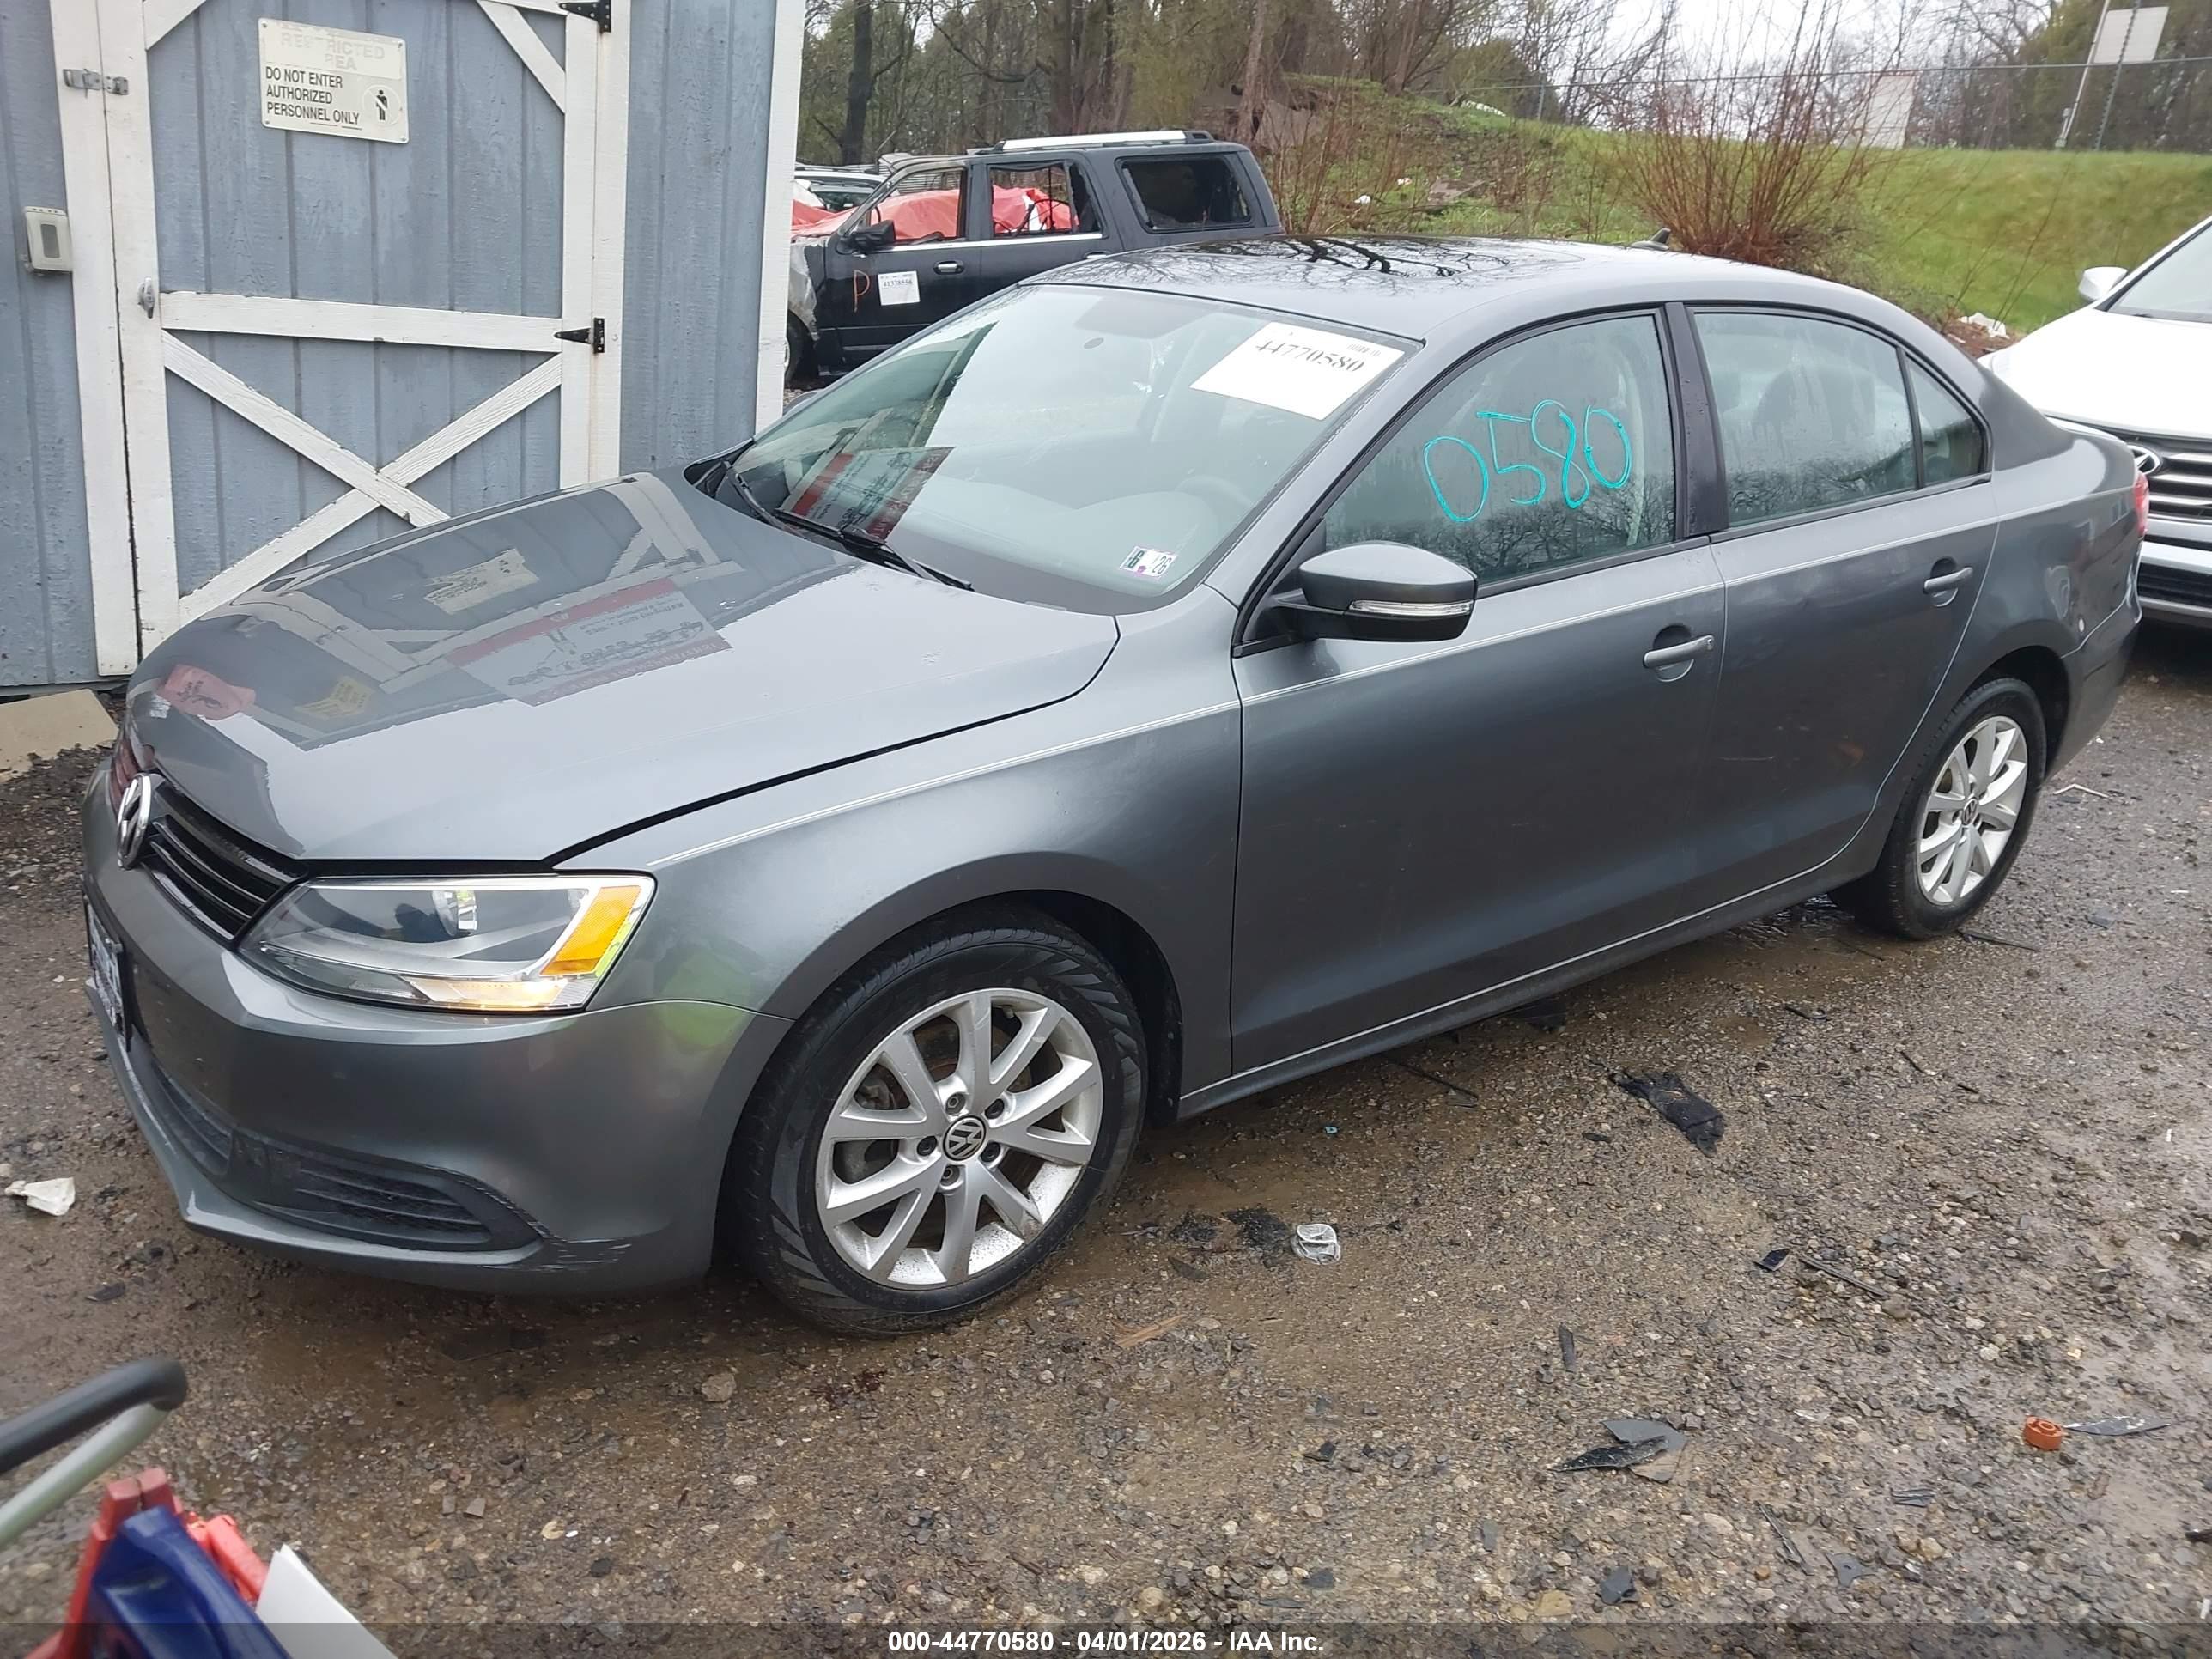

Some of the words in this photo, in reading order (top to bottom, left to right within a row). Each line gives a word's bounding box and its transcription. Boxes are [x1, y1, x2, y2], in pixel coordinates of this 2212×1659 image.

[265, 66, 281, 81] DO
[284, 69, 306, 84] NOT
[309, 72, 343, 88] ENTER
[266, 84, 332, 105] AUTHORIZED
[267, 101, 331, 122] PERSONNEL
[333, 110, 360, 125] ONLY
[1255, 340, 1366, 372] 44770580
[1422, 399, 1632, 523] 0580
